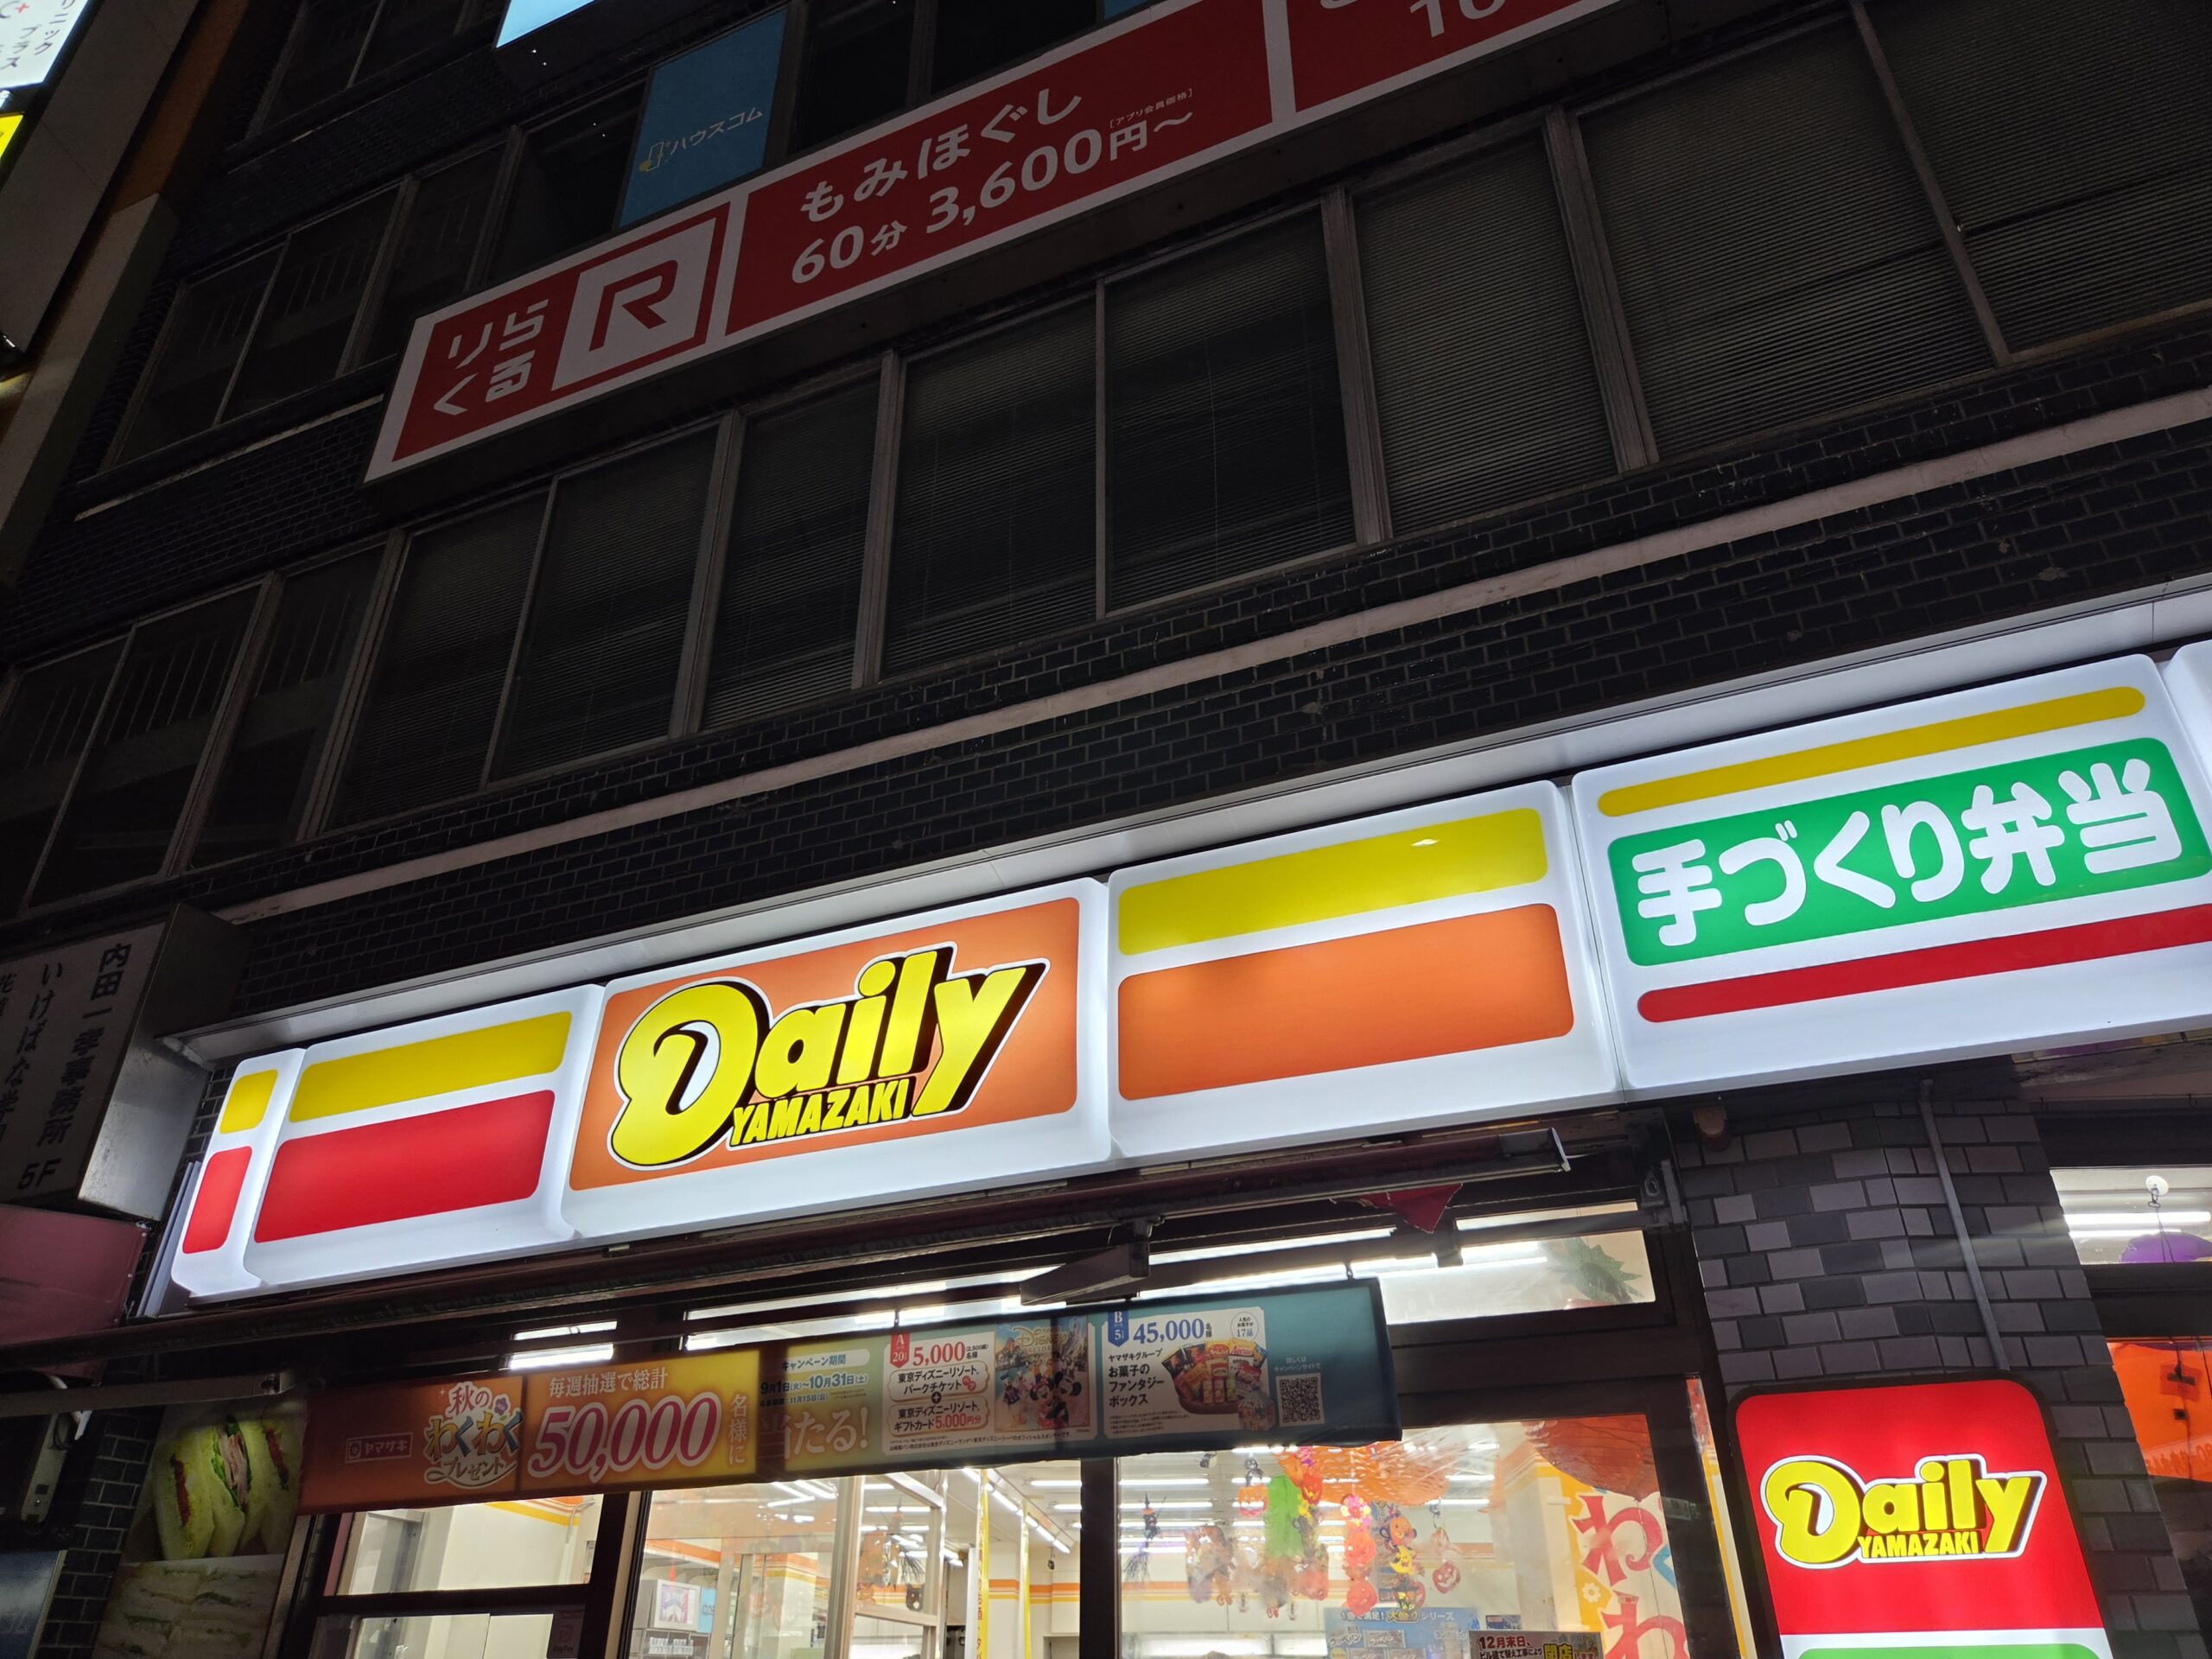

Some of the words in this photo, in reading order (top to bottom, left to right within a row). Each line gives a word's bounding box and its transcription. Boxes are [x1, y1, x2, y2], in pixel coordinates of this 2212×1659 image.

[670, 107, 763, 156] ハウスコム
[799, 87, 1082, 222] もみほぐし
[791, 220, 907, 284] 60分
[589, 259, 678, 352] R
[1630, 758, 2183, 947] 手づくり弁当
[609, 944, 1048, 1166] Daily
[730, 1077, 912, 1147] YAMAZAKI
[17, 1157, 61, 1190] 5F
[1133, 1319, 1205, 1344] 45,000
[782, 1354, 846, 1371] キャンペーン期間
[912, 1342, 965, 1366] 5,000
[1109, 1363, 1150, 1378] お菓子の
[448, 1384, 490, 1414] 秋の
[549, 1367, 668, 1398] 毎週抽選で総計
[904, 1380, 962, 1395] パークチケット
[1109, 1376, 1165, 1392] ファンタジー
[1109, 1394, 1148, 1408] ボックス
[427, 1409, 524, 1462] わくわく
[529, 1395, 719, 1480] 50,000
[728, 1394, 748, 1465] 名様に
[443, 1456, 505, 1480] プレゼント
[1764, 1458, 2041, 1564] Daily
[1857, 1530, 1980, 1559] YAMAZAKI
